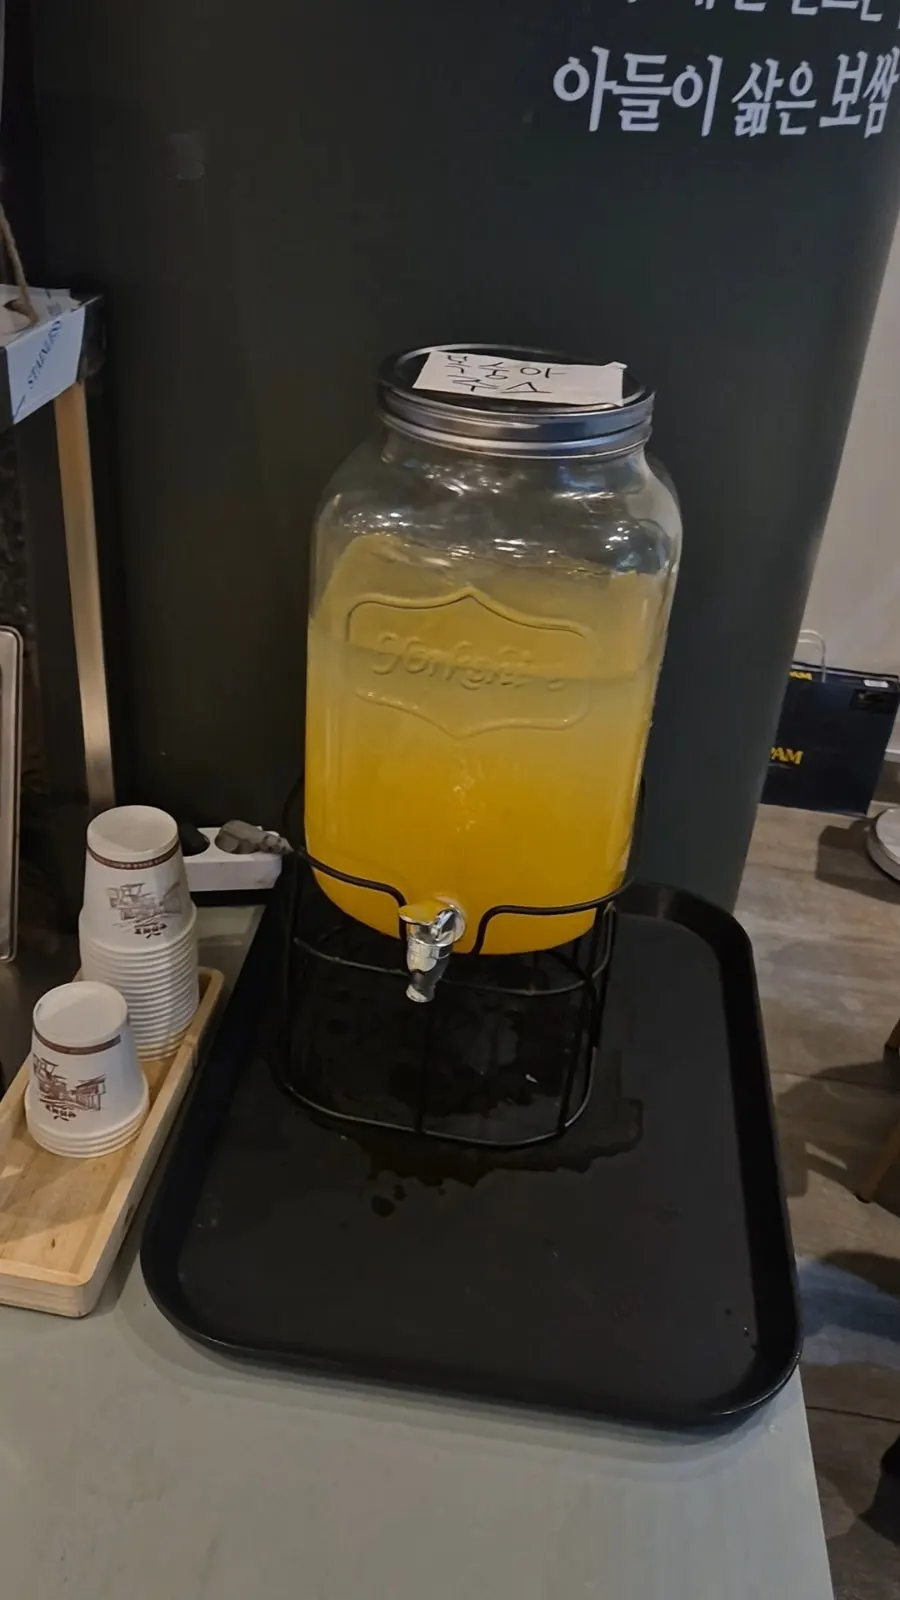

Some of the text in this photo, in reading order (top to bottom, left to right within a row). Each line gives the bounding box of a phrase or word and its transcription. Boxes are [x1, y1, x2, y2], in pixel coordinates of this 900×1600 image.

[553, 45, 900, 138] 아들이 삶은 보쌈
[445, 354, 568, 380] 복숭아
[446, 374, 552, 394] 주스
